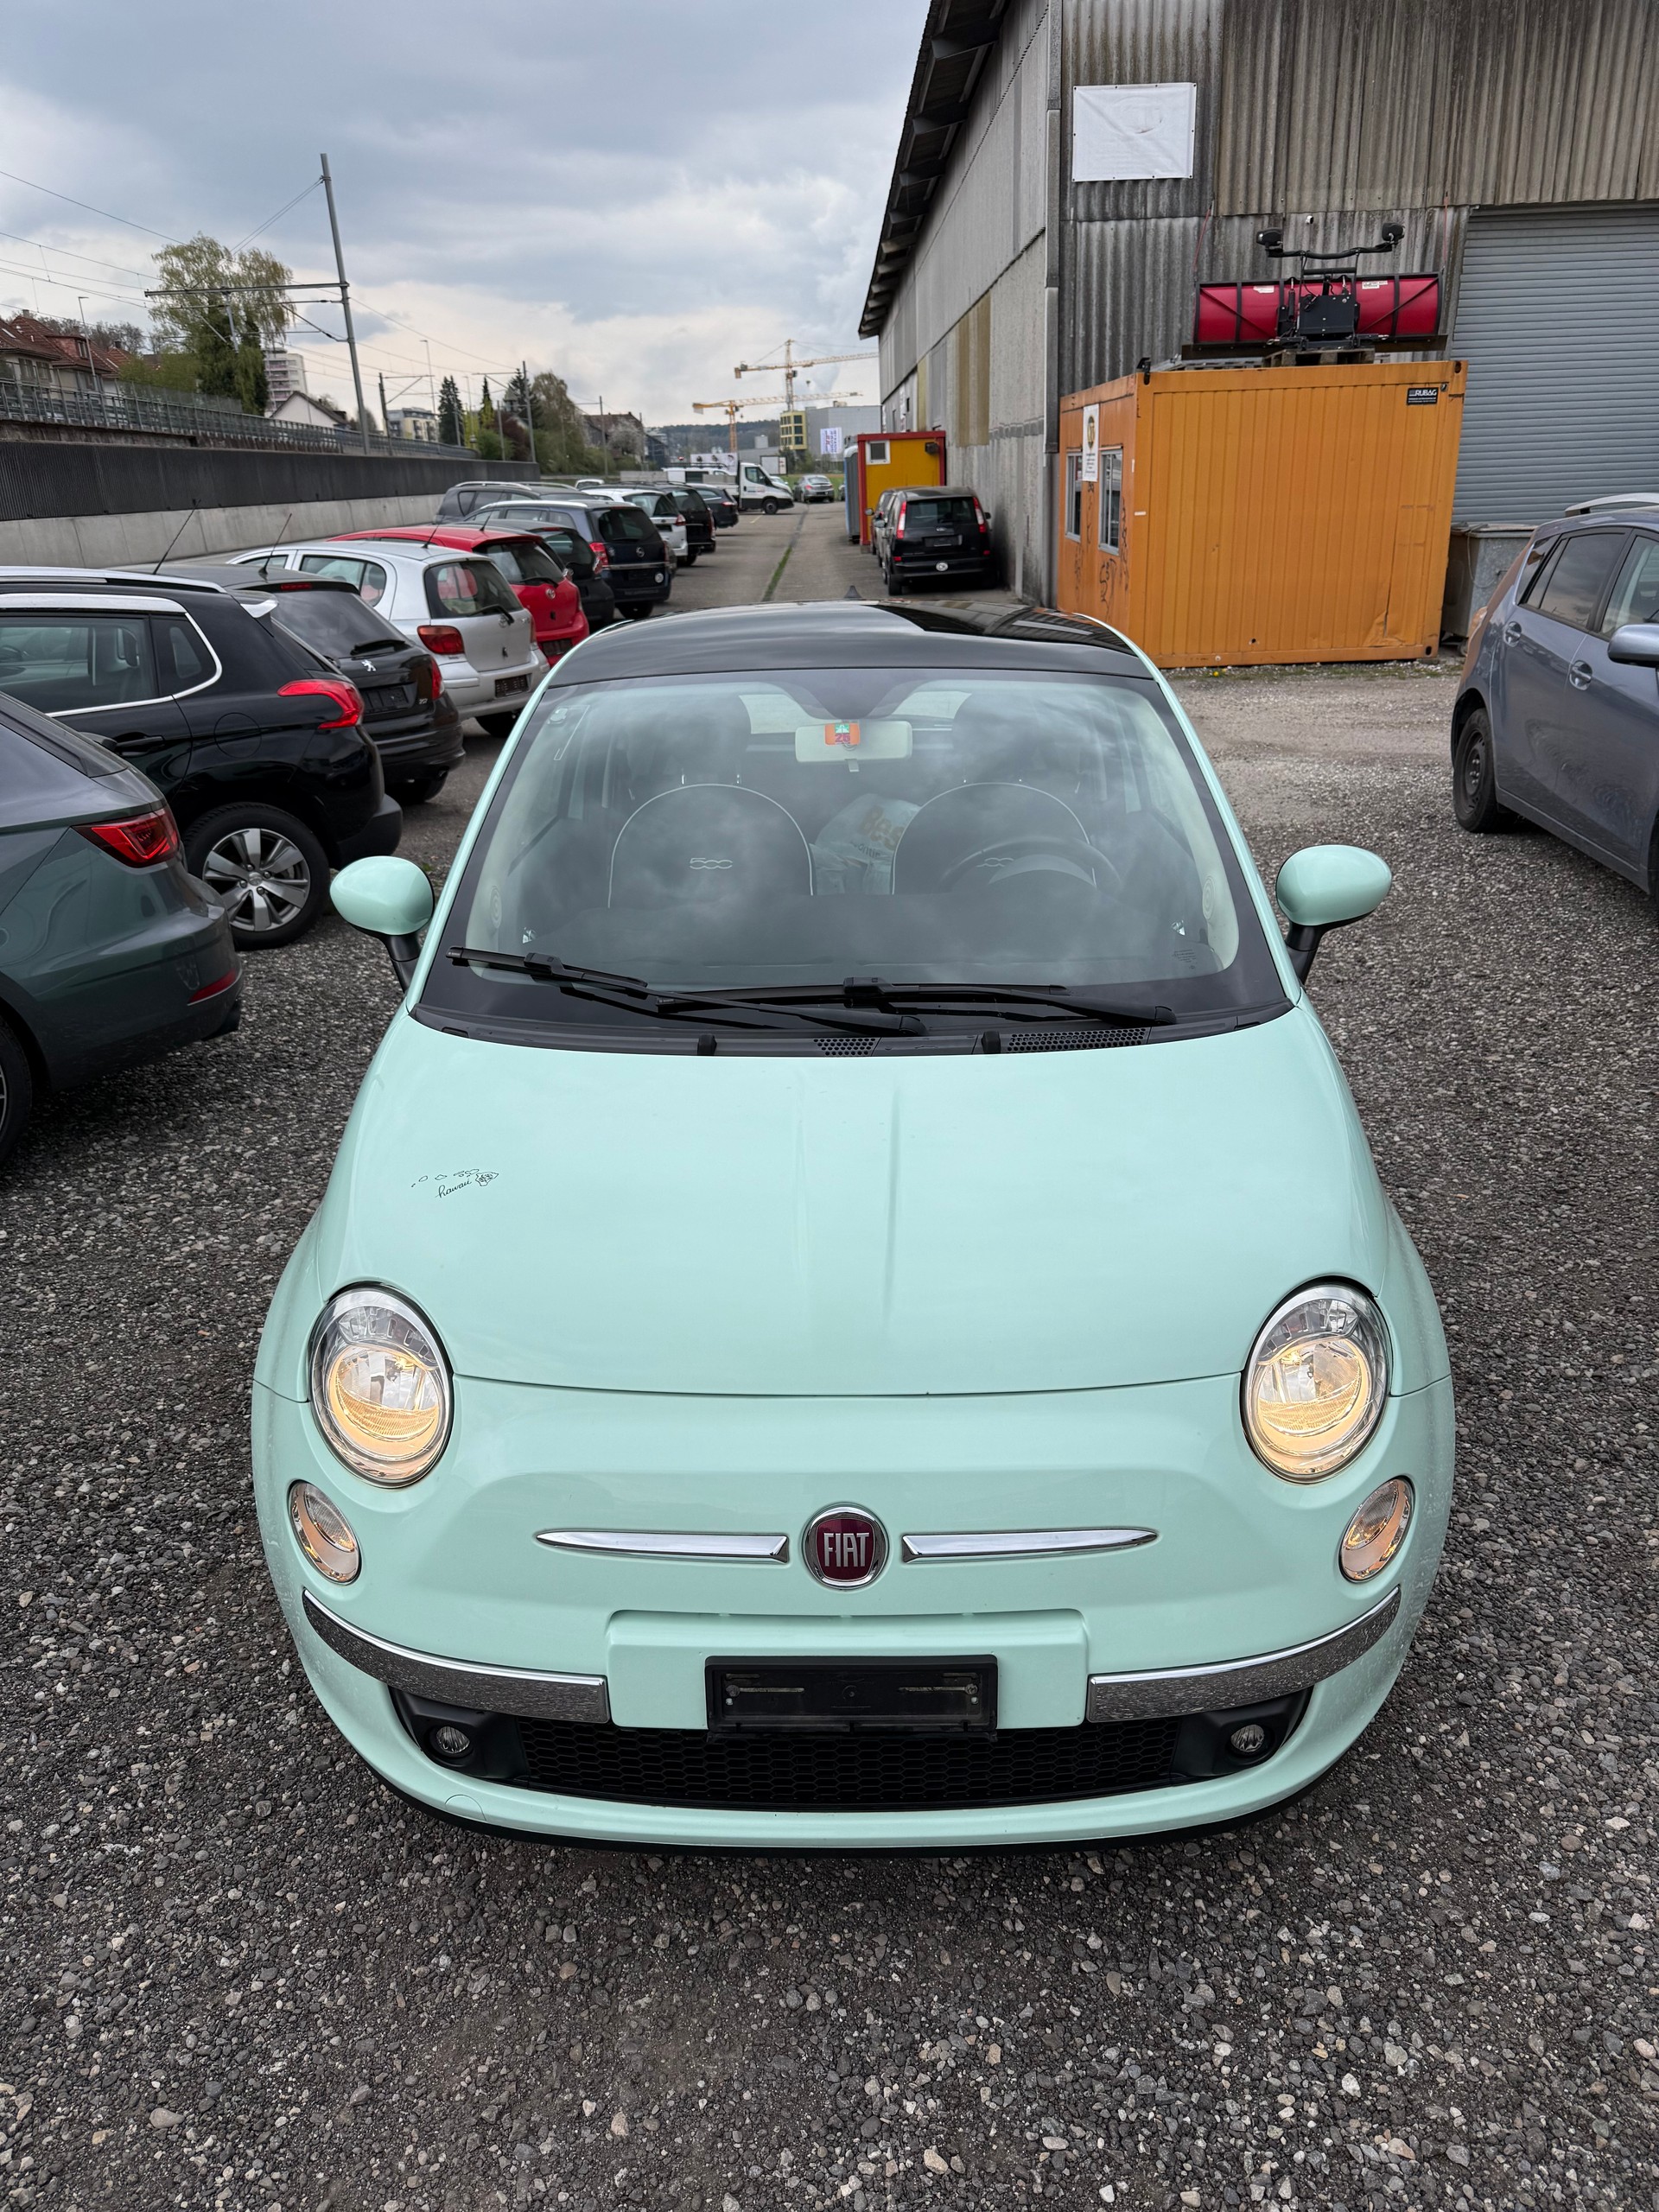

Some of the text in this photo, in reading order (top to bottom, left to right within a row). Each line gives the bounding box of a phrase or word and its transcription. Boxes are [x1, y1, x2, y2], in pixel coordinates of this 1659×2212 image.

[690, 857, 733, 870] 500
[976, 857, 1014, 868] 00
[823, 1532, 869, 1567] FIAT
